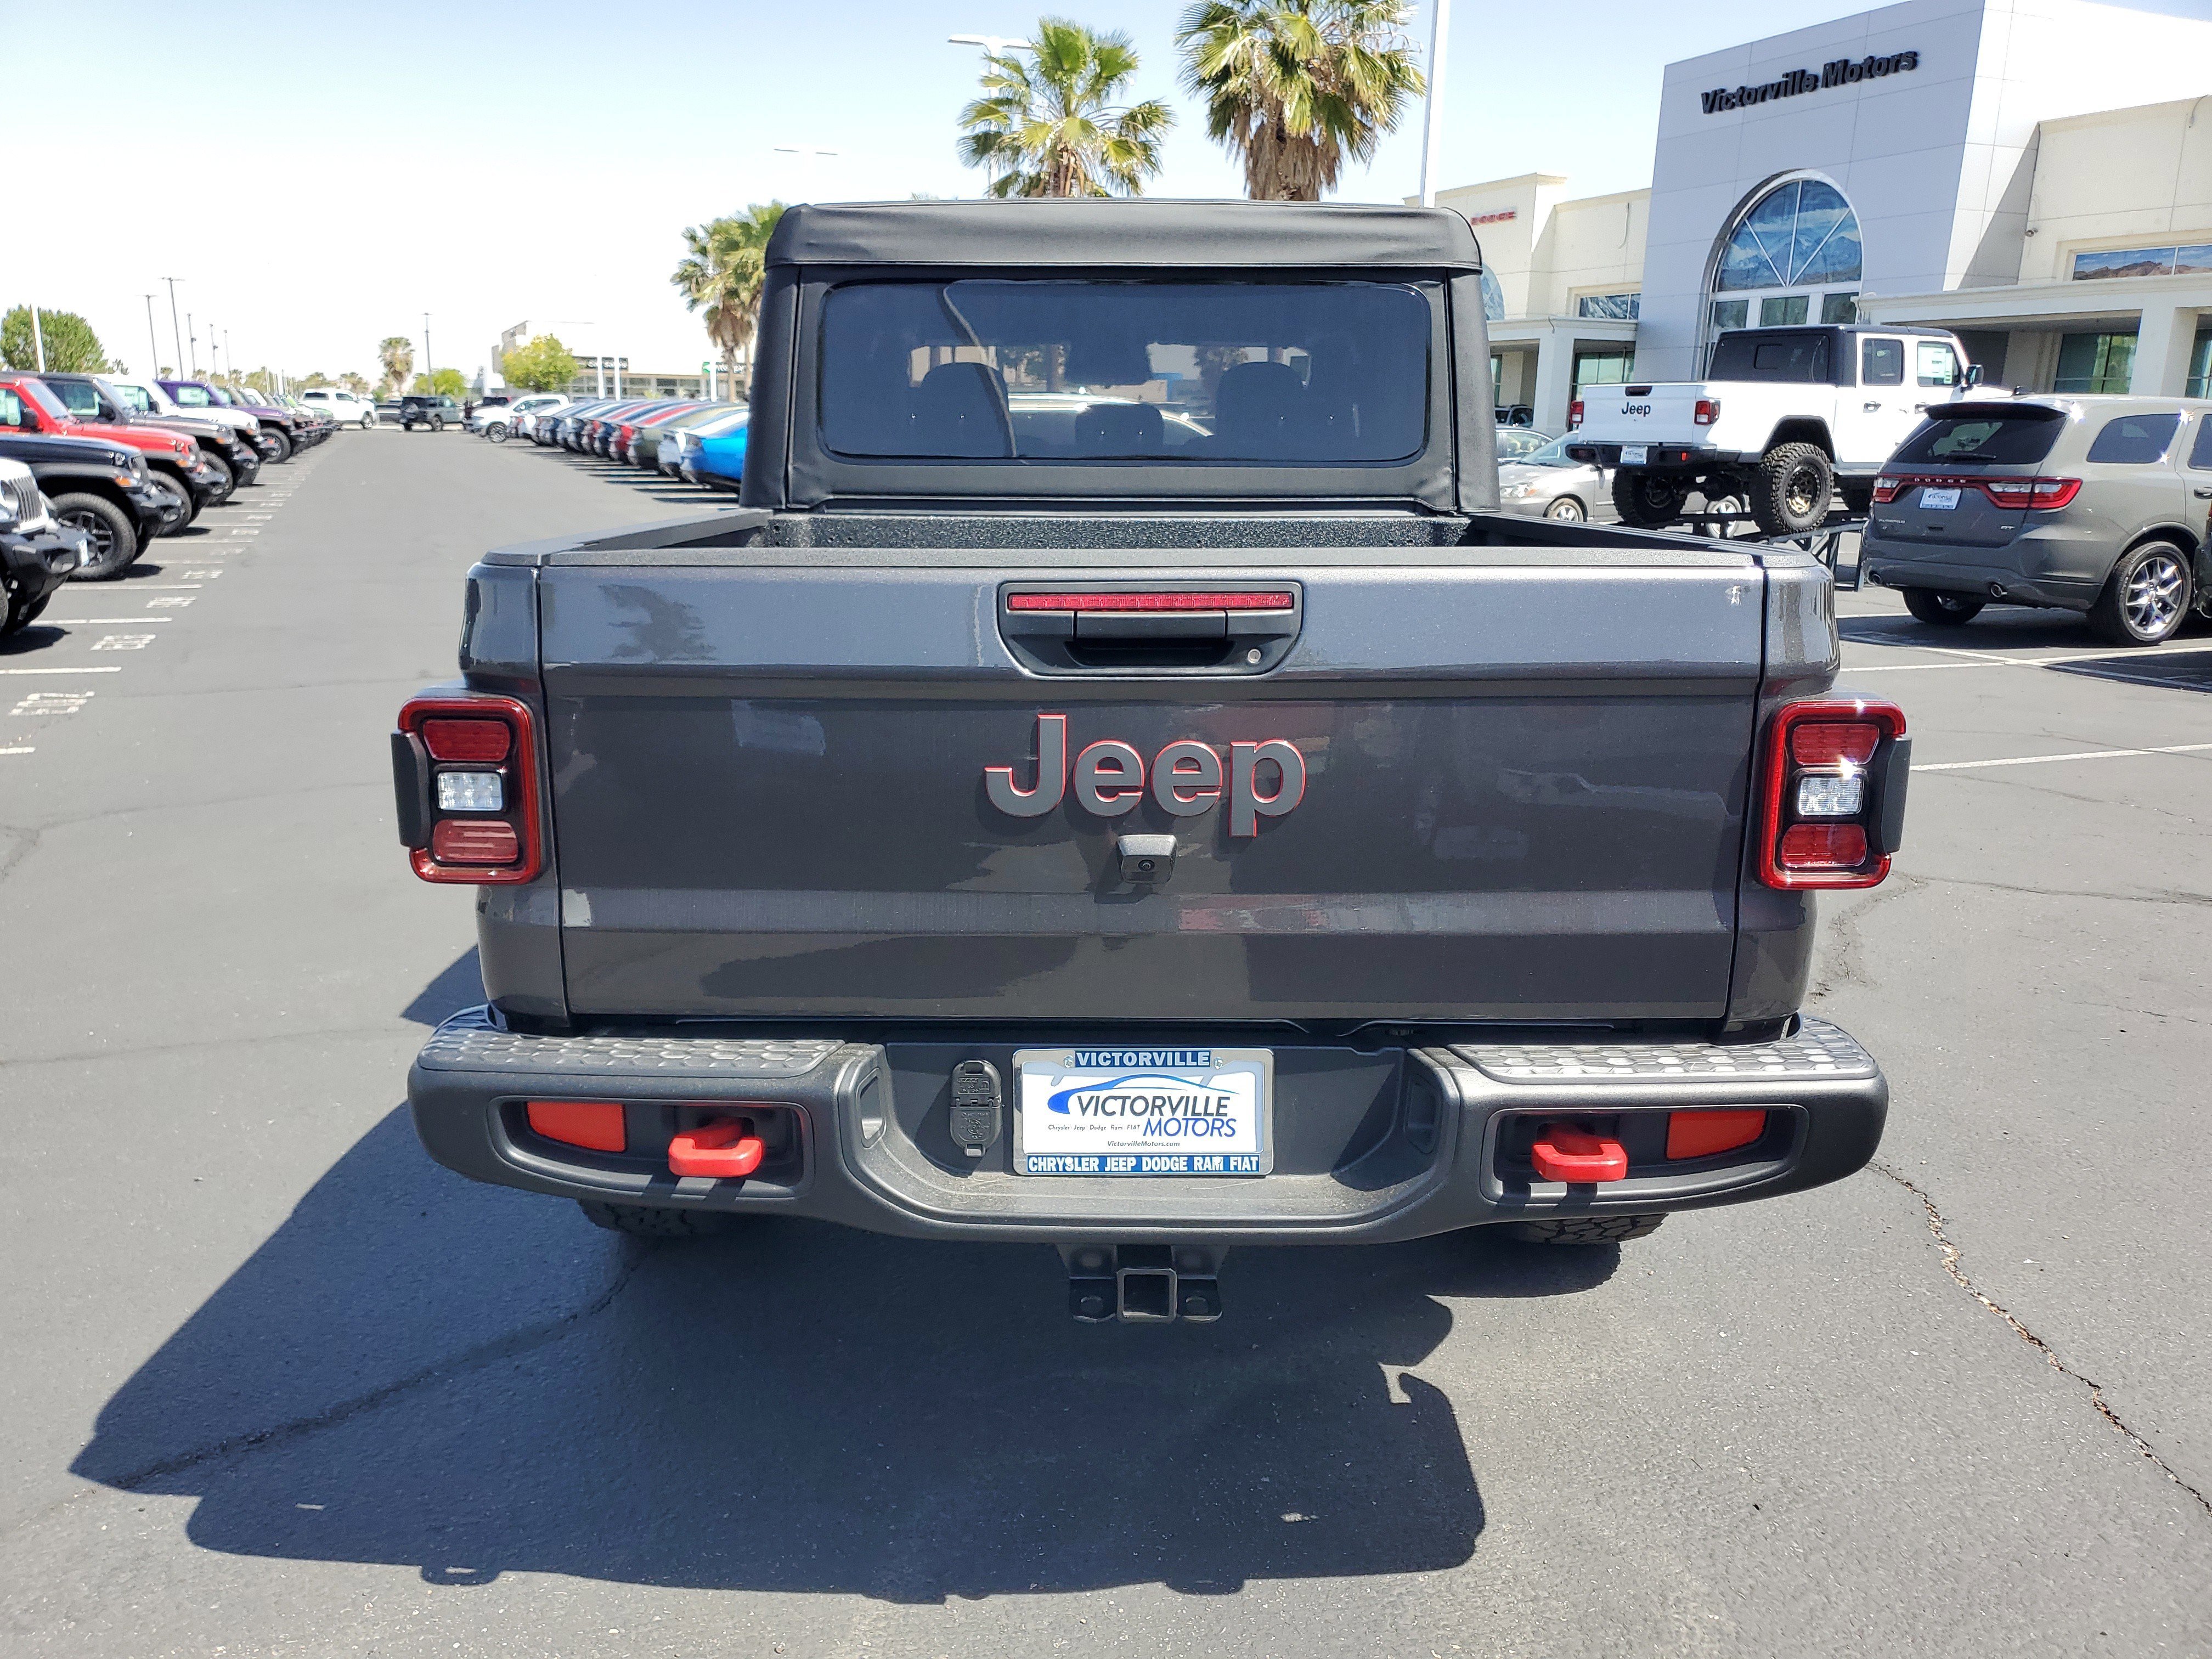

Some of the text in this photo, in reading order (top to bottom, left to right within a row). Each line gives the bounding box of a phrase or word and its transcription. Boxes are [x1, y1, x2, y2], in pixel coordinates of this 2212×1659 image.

[1701, 50, 1918, 114] Victorville Motors
[1621, 402, 1651, 417] Jeep
[985, 714, 1306, 838] Jeep
[1075, 1051, 1210, 1067] VICTORVILLE
[1077, 1095, 1231, 1118] VICTORVILLE
[1048, 1124, 1070, 1132] Chrysler
[1074, 1124, 1086, 1132] Jeep
[1090, 1124, 1107, 1132] Dodge
[1143, 1117, 1237, 1138] MOTORS
[1028, 1156, 1258, 1172] CHRYSLER JEEP DODGE RAM FIAT
